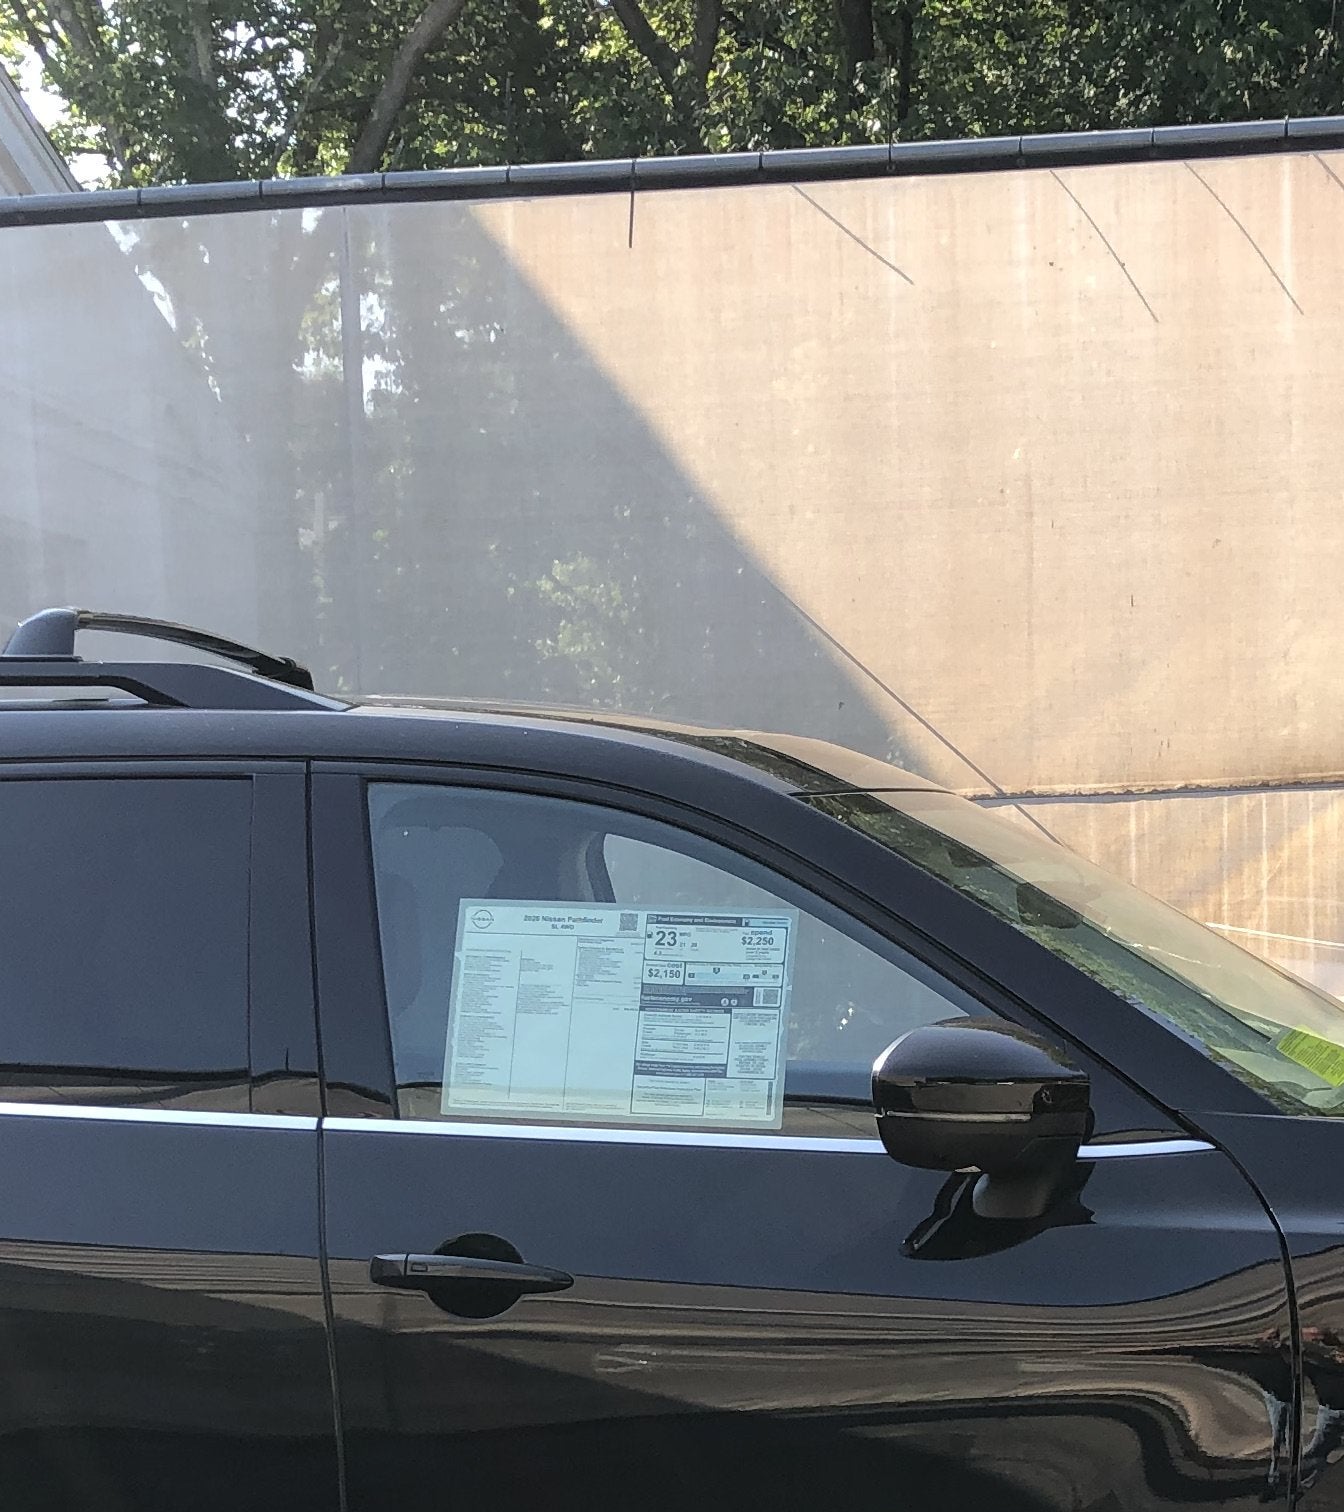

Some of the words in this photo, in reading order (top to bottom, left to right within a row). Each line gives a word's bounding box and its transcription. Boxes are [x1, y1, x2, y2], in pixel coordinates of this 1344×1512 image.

[654, 930, 677, 947] 23
[741, 936, 774, 946] $2,250
[647, 968, 681, 979] $2,150
